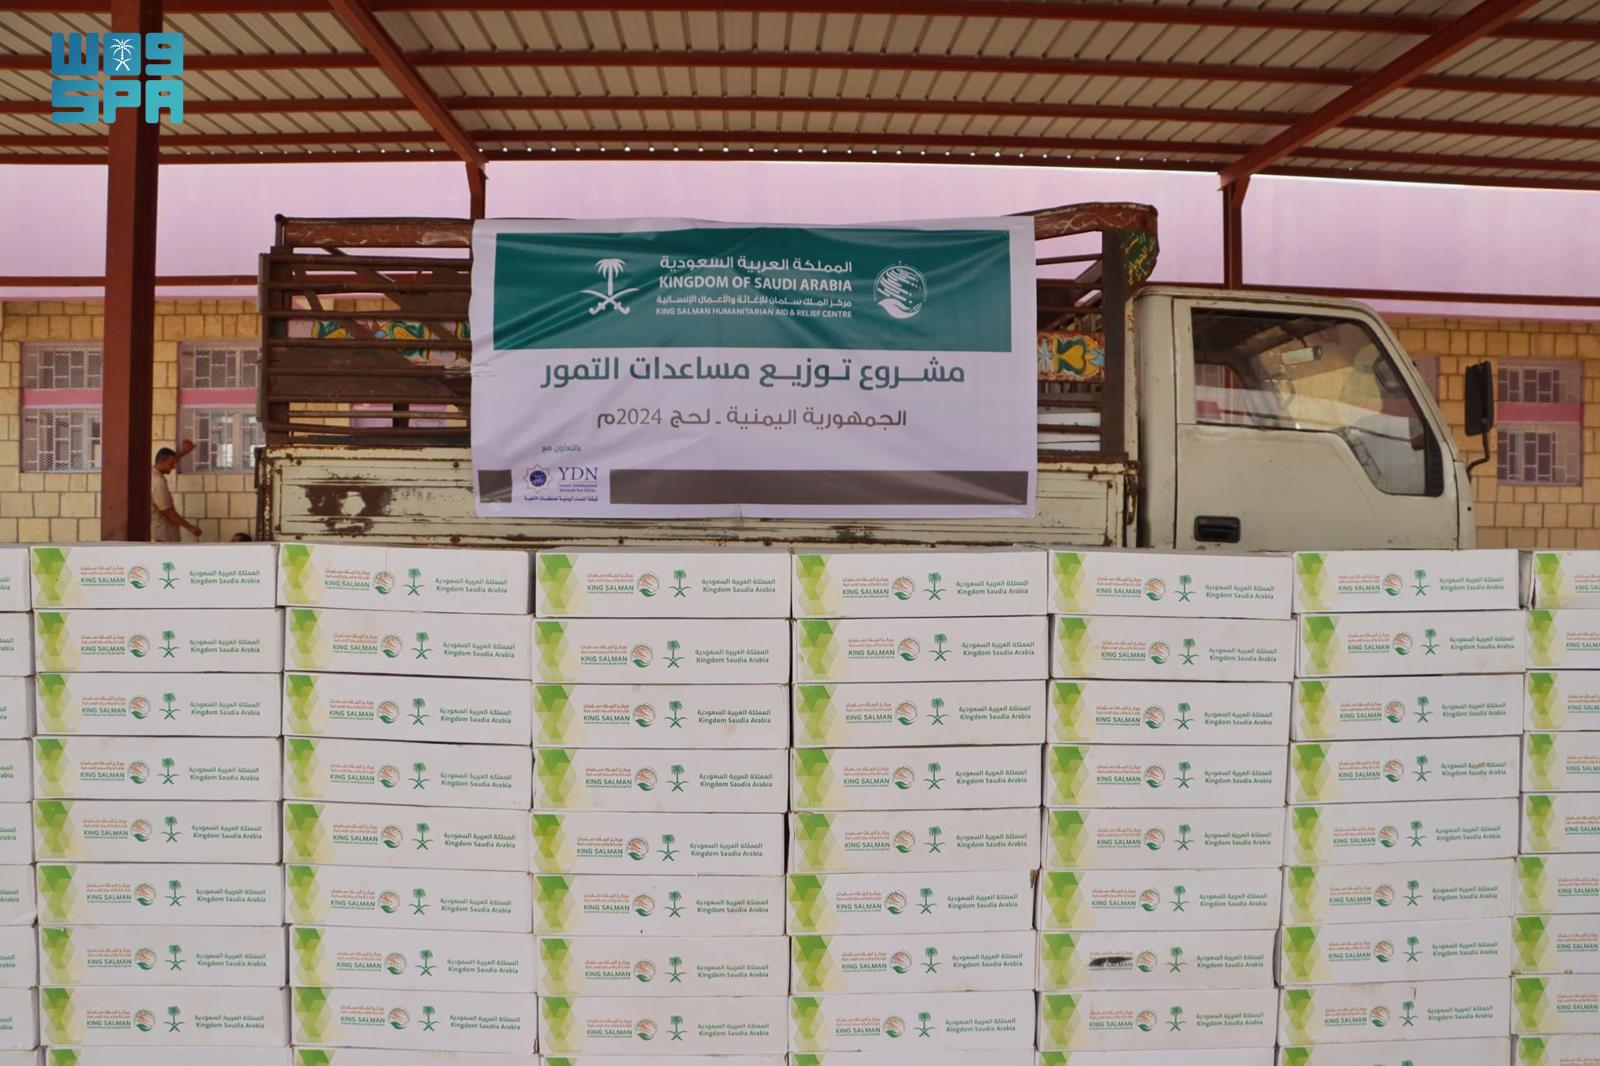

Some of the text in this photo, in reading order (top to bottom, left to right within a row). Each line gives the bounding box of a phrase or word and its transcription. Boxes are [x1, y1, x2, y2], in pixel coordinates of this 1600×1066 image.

[660, 256, 852, 273] المملكة العربية السعودية
[659, 275, 852, 292] KINGDOM OF SAUDI ARABIA
[768, 296, 801, 305] سلمان
[802, 298, 828, 306] الملك
[829, 298, 852, 307] مركز
[656, 307, 675, 315] KING
[676, 307, 710, 315] SALMAN
[712, 307, 773, 315] HUMANITARIAN
[797, 309, 821, 317] RELIEF
[822, 310, 852, 318] CENTRE
[540, 356, 965, 390] مشروع توزيع مساعدات التمور
[597, 408, 662, 429] 2024م
[670, 408, 710, 429] لحج
[726, 406, 797, 430] اليمنية
[803, 407, 907, 431] الجمهورية
[542, 445, 552, 453] مع
[558, 467, 598, 480] YDN
[703, 586, 731, 594] Kingdom
[444, 649, 471, 658] Kingdom
[191, 709, 218, 717] Kingdom
[700, 781, 728, 789] Kingdom
[1437, 834, 1461, 843] Kingdom
[448, 966, 475, 974] Kingdom
